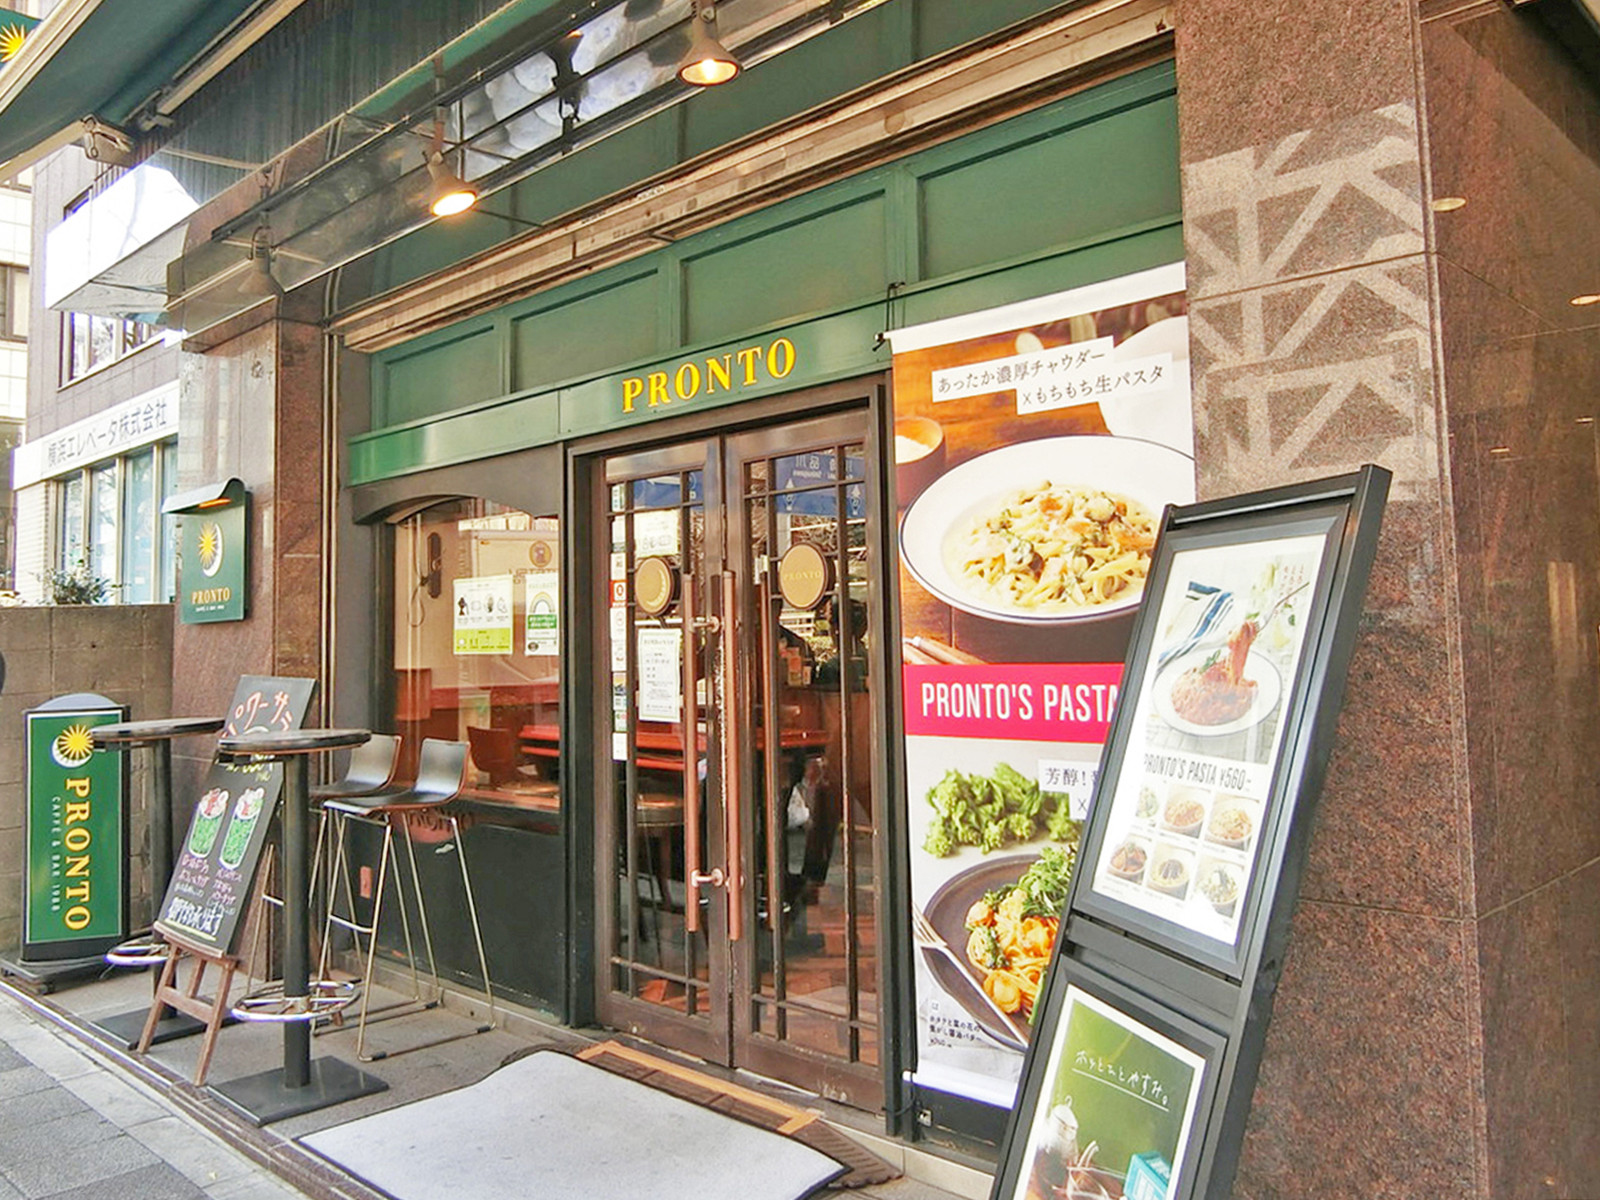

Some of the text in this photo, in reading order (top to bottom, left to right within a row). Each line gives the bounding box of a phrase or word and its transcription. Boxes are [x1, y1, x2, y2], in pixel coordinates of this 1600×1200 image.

[622, 337, 797, 414] PRONTO
[938, 349, 1105, 394] あったか濃厚チャウダー
[783, 569, 822, 581] PRONTO
[191, 587, 231, 605] PRONTO
[921, 682, 1034, 720] PRONTO'S
[1187, 761, 1218, 785] PASTA
[52, 854, 61, 877] BAR
[65, 777, 92, 931] PRONTO
